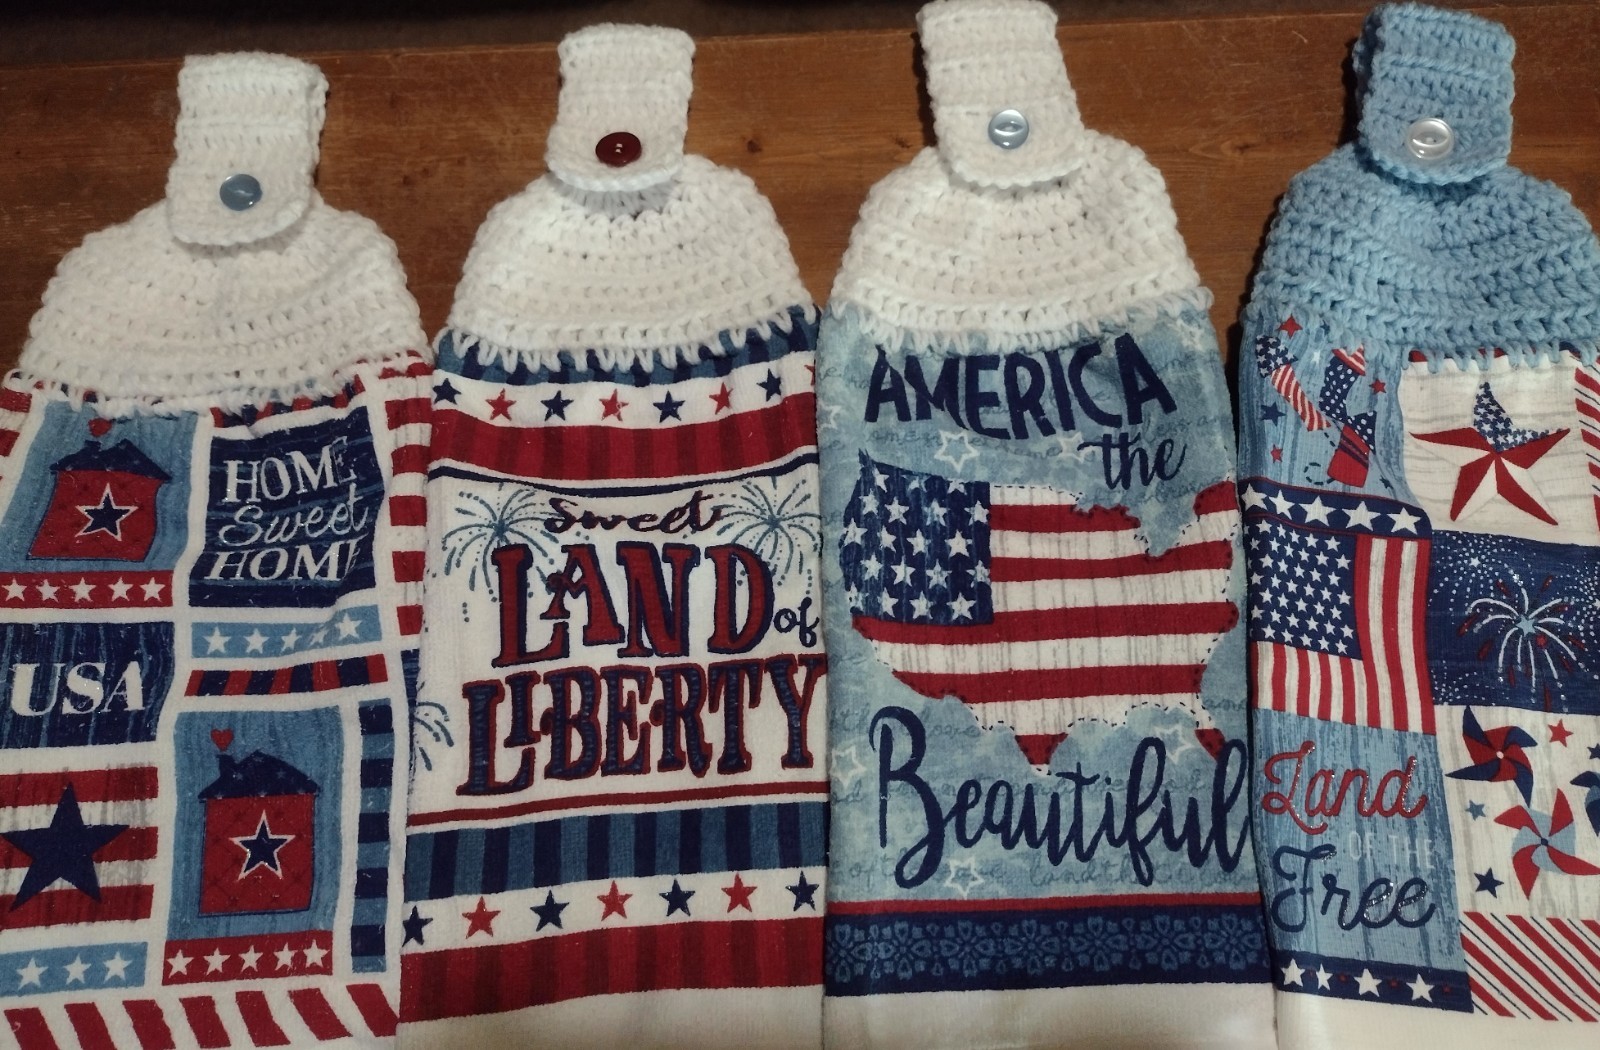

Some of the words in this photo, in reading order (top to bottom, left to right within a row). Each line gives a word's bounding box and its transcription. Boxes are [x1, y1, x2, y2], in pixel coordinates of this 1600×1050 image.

[865, 333, 1178, 440] AMERICA
[1078, 432, 1186, 490] the
[219, 482, 369, 546] Sweet
[543, 490, 722, 533] Sweet
[491, 540, 775, 668] LAND
[773, 596, 820, 647] of
[10, 660, 146, 717] USA
[455, 653, 828, 796] LIBERTY
[869, 705, 1249, 889] Beautiful
[1261, 740, 1428, 835] Land
[1269, 844, 1436, 932] Free
